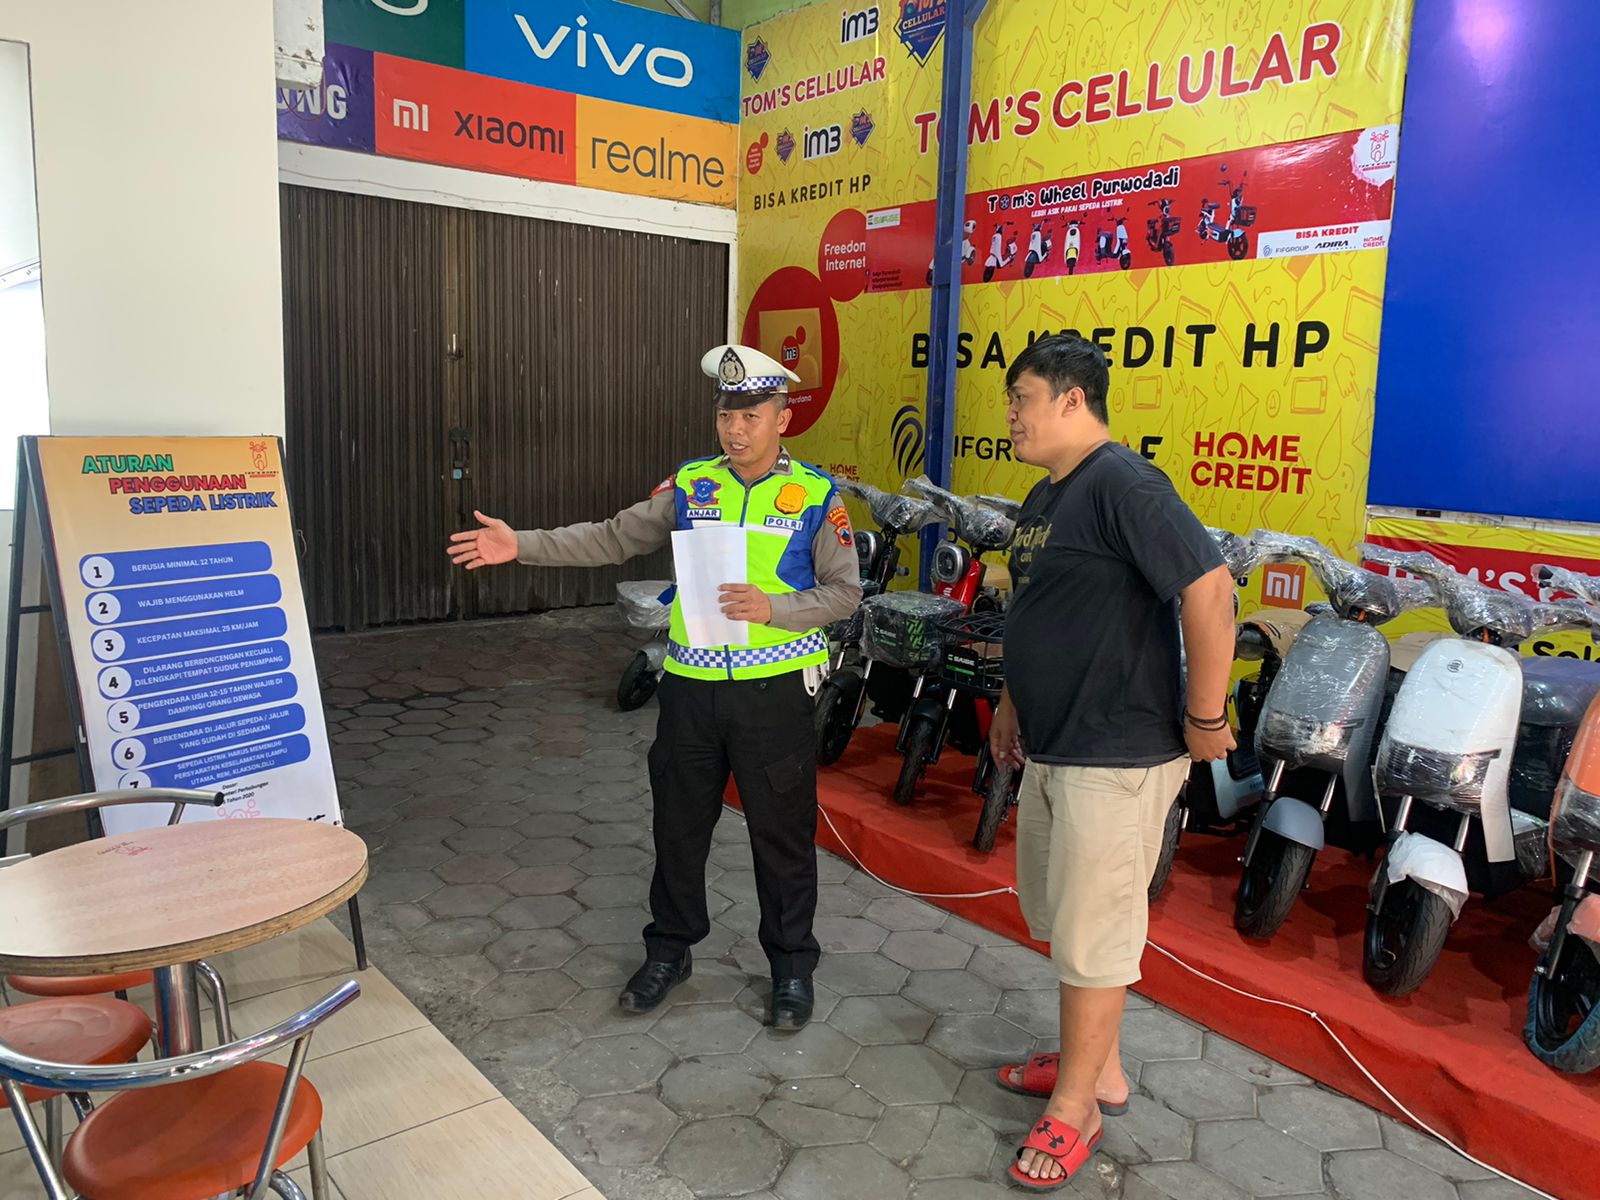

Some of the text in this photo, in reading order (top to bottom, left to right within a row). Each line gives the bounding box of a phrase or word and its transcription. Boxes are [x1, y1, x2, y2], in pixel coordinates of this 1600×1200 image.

[841, 7, 880, 43] im3
[514, 15, 694, 88] vivo
[743, 57, 886, 116] TOM'S CELLULAR
[914, 21, 1342, 154] TM'S CELLULAR
[454, 111, 564, 155] xiaomi
[804, 125, 841, 158] im3
[591, 137, 724, 188] realme
[754, 174, 871, 210] BISA KREDIT HP
[1040, 183, 1087, 206] Wheel
[1093, 166, 1180, 196] Purwodadi
[1078, 202, 1100, 211] SEPEDA
[1101, 198, 1124, 208] LISTRIK
[1295, 225, 1359, 239] BISA KREDIT
[1275, 245, 1310, 253] FIFGROUP
[783, 346, 798, 360] im3
[911, 321, 1330, 369] BSA EDIT HP
[1194, 431, 1300, 463] HOME
[81, 454, 174, 474] ATURAN
[830, 464, 857, 475] HOME
[1190, 459, 1312, 494] CREDIT
[109, 474, 247, 494] PENGGUNAAN
[129, 491, 278, 515] SEPEDA LISTRIK
[767, 517, 802, 530] POLRI
[93, 566, 102, 579] 1
[131, 562, 166, 572] BERUSIA
[166, 559, 200, 569] MINIMAL
[209, 557, 234, 565] TAHUN
[98, 589, 244, 614] 2 WAJIB MENGGUNAKAN HELM
[104, 621, 259, 652] 3 KECEPATAN MAKSIMAL 25 KM/JAM
[134, 656, 283, 687] DILENGKAPI TEMPAT DUDUK PENUMPANG
[143, 647, 273, 674] DILARANG BERBONCENGAN KECUALI
[108, 677, 119, 689] 4
[137, 695, 190, 711] PENGENDARA
[191, 692, 209, 701] USIA
[209, 689, 228, 697] 12-15
[228, 684, 254, 693] TAHUN
[254, 679, 275, 688] WAJIB
[167, 692, 262, 716] DAMPINGI ORANG DEWASA
[119, 711, 129, 724] 5
[153, 730, 204, 745] BERKENDARA
[213, 721, 237, 732] JALUR
[237, 716, 264, 727] SEPEDA
[268, 710, 289, 720] JALUR
[179, 739, 201, 749] YANG
[201, 734, 226, 745] SUDAH
[236, 724, 270, 737] SEDIAKAN
[124, 747, 134, 760] 6
[177, 759, 204, 770] SEPEDA
[204, 753, 227, 764] LISTRIK
[227, 748, 249, 757] HARUS
[174, 764, 220, 780] PERSYARATAN
[221, 754, 265, 768] KESELAMATAN
